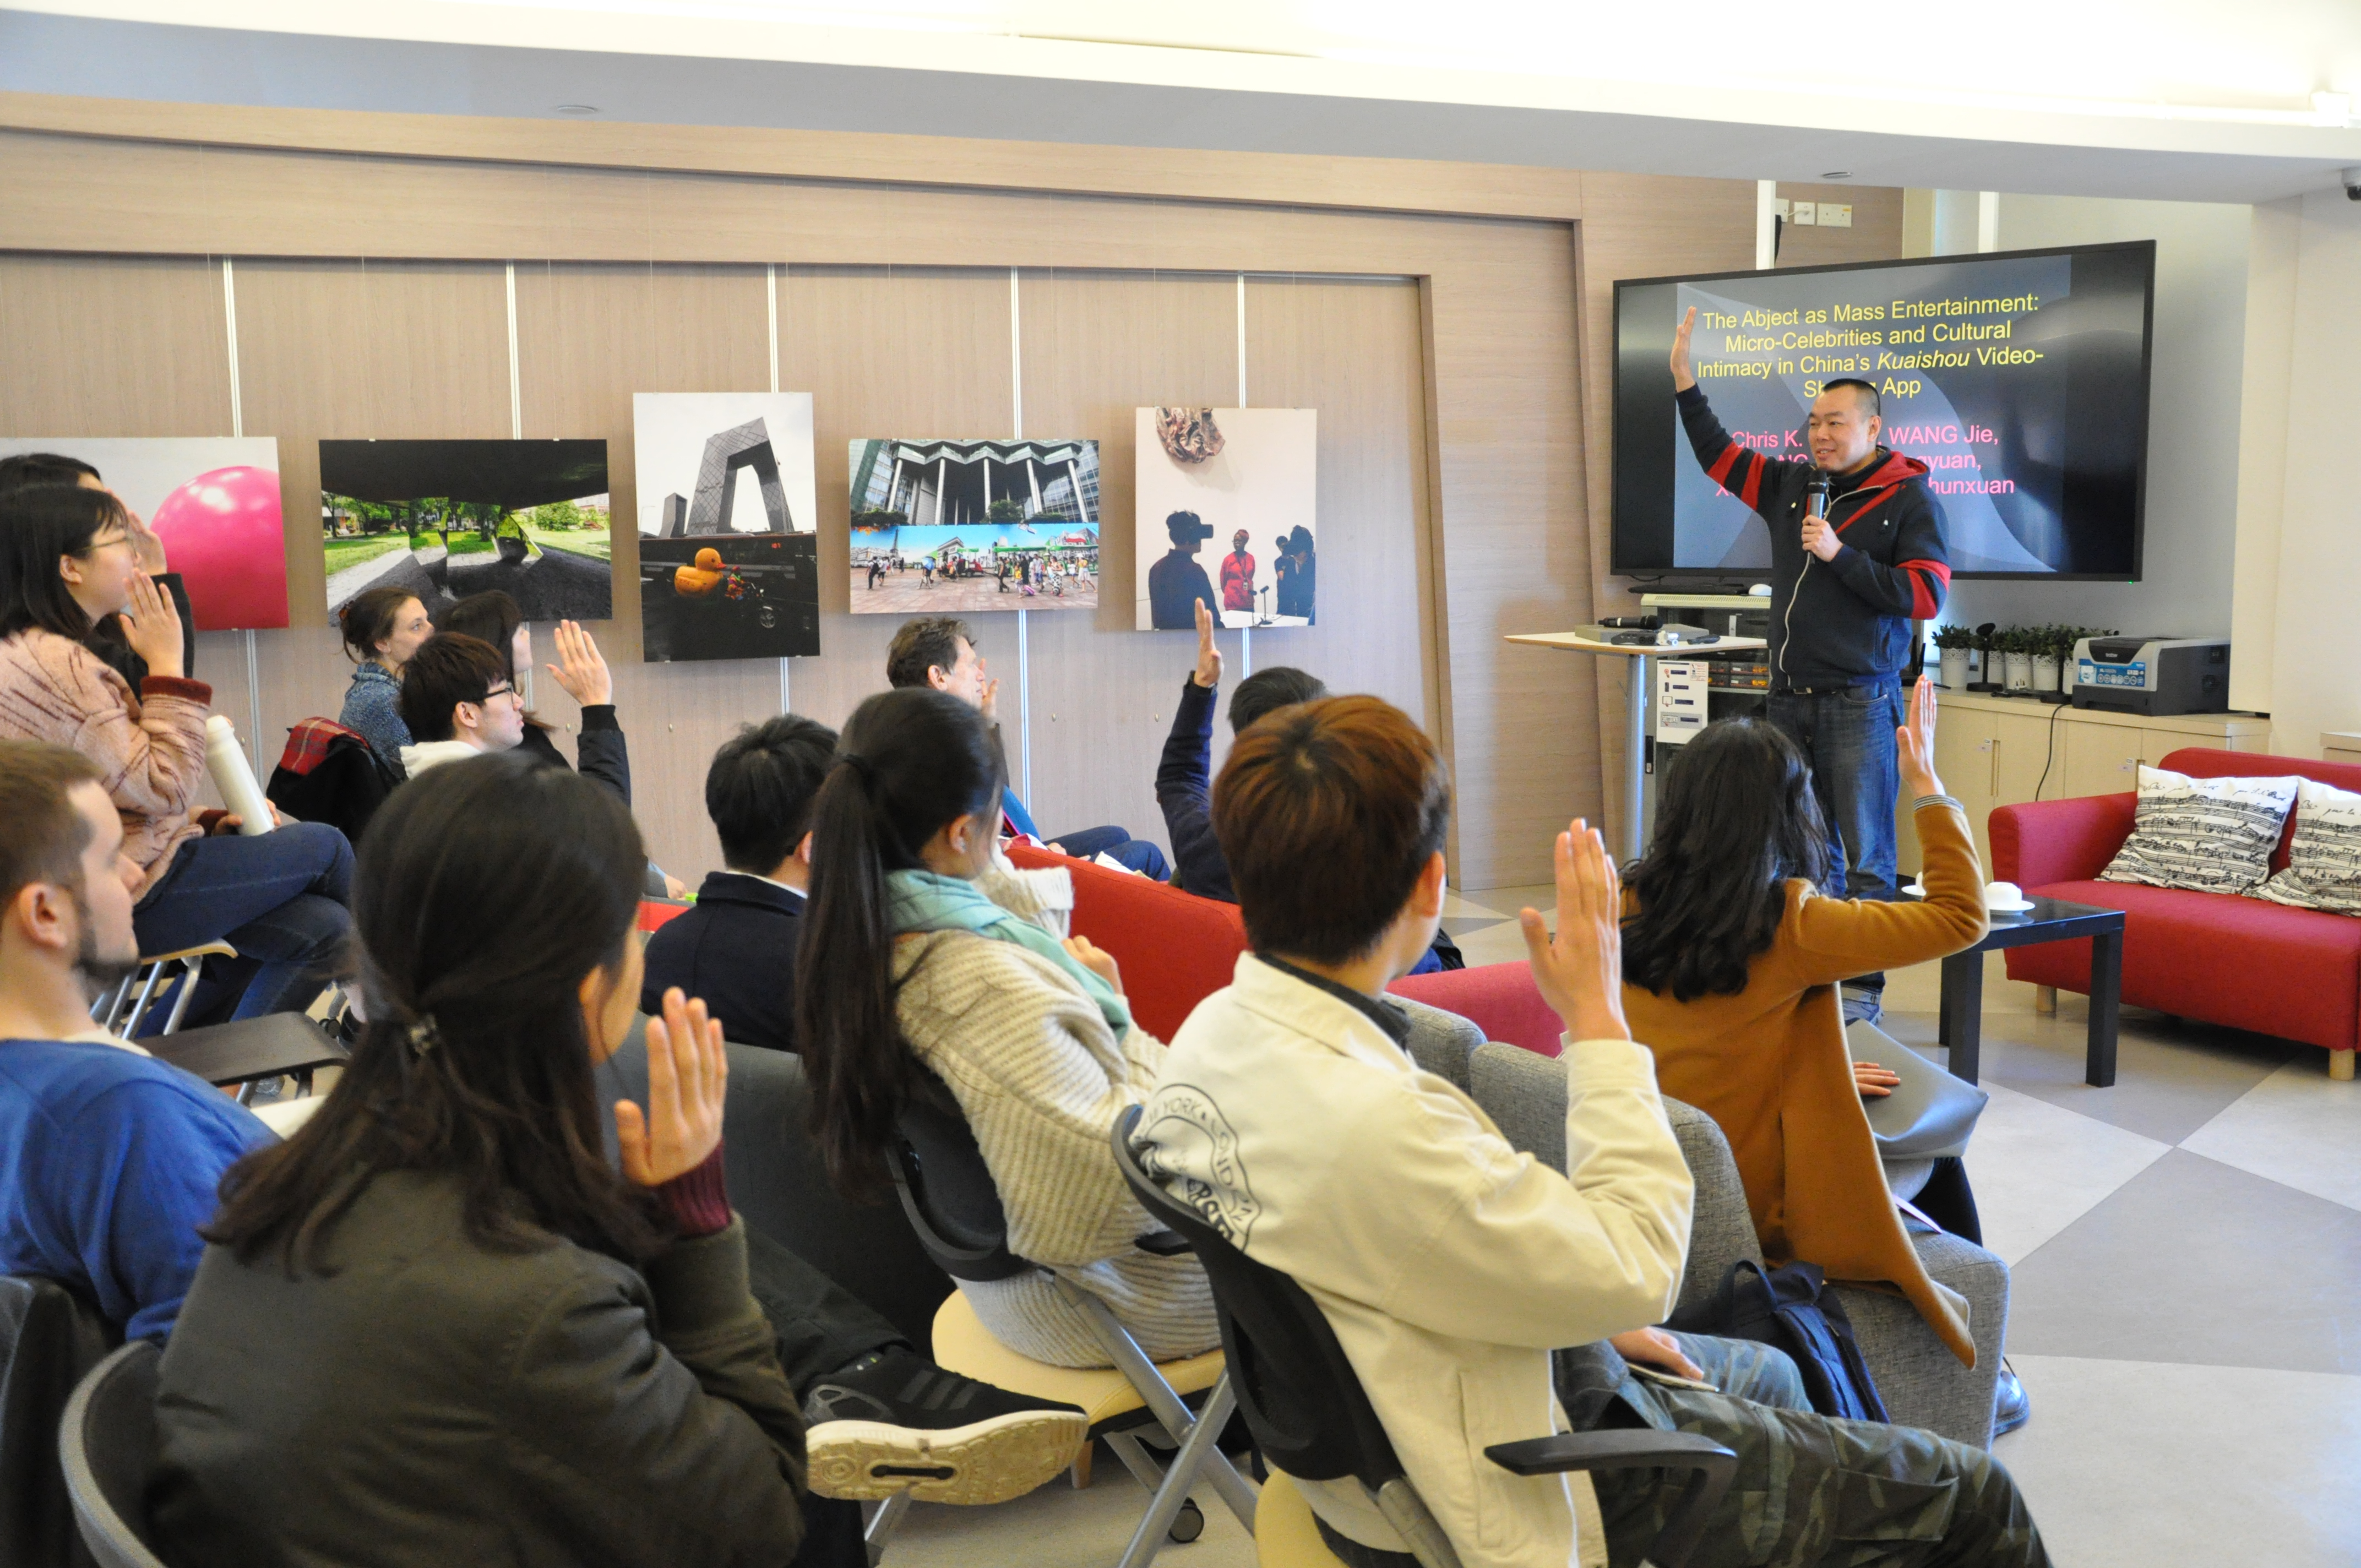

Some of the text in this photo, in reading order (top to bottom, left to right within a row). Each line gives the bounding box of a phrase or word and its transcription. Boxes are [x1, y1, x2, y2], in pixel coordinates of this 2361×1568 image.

[1702, 293, 2039, 331] The Abject as Mass Entertainment:
[1726, 320, 2011, 352] Micro-Celebrities and Cultural
[1698, 346, 2044, 379] Intimacy in China's Kuaishou Video-
[1881, 377, 1922, 398] App
[1732, 424, 1999, 448] Chris K. WANG Jie,
[1928, 477, 2015, 494] hunxuan
